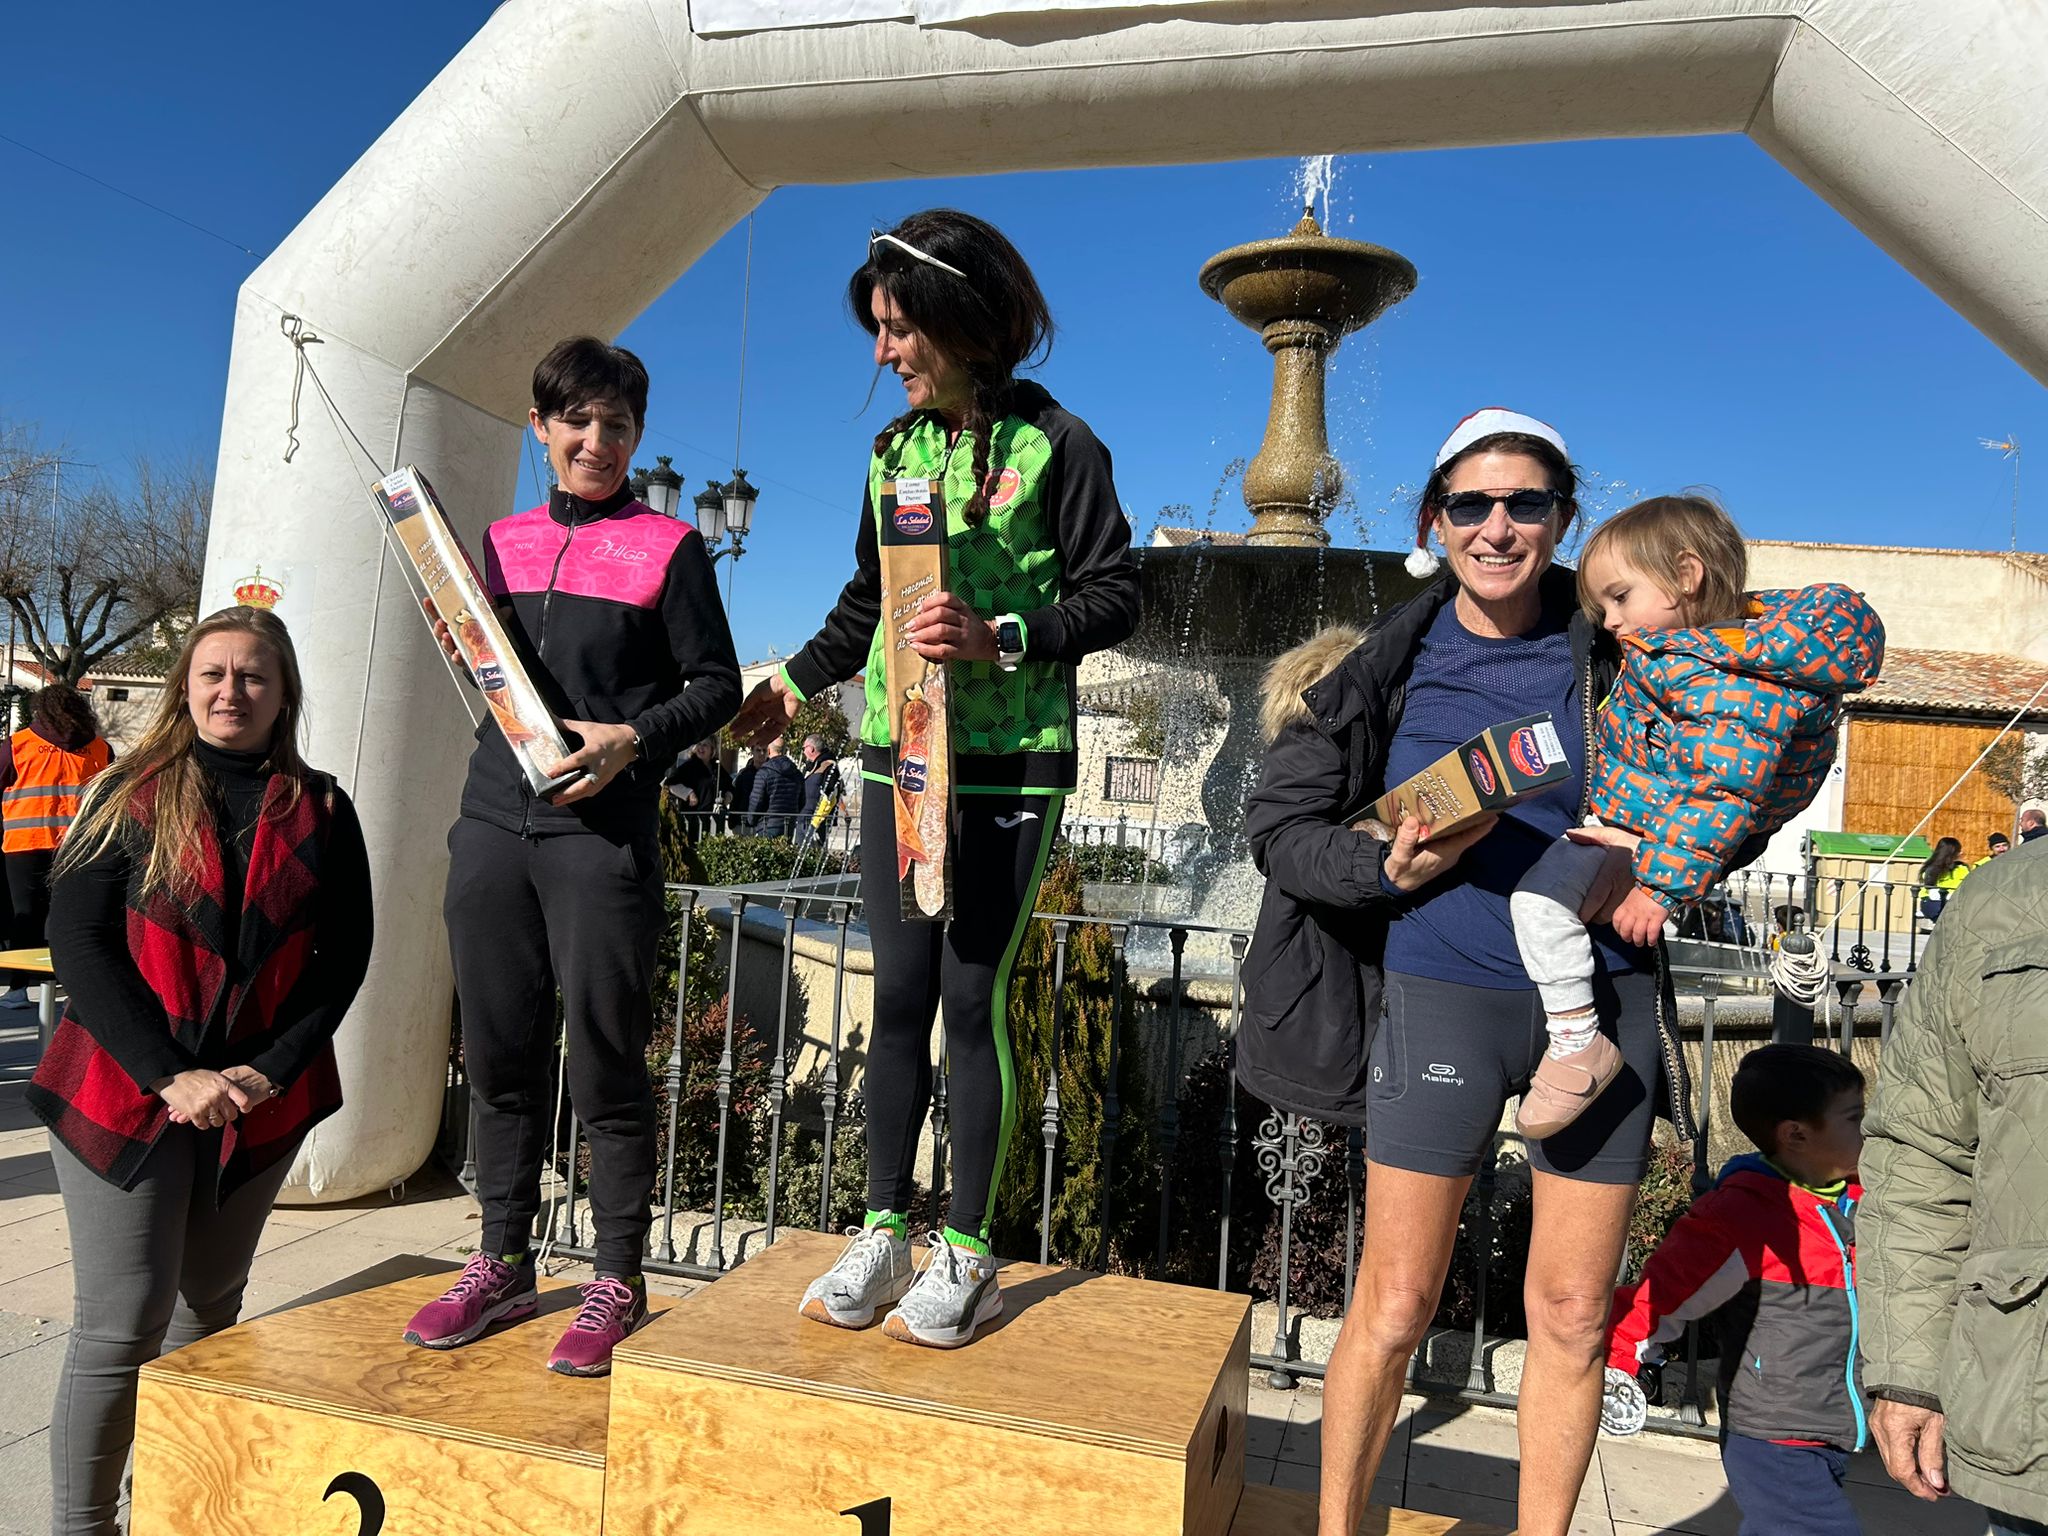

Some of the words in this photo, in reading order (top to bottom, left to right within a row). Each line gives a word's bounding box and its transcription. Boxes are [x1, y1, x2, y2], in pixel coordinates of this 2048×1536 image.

[897, 516, 907, 525] La
[901, 573, 934, 598] Hacemos
[893, 607, 902, 619] de
[903, 603, 911, 613] lo
[897, 634, 906, 651] de
[1424, 772, 1433, 780] de
[1436, 790, 1461, 819] natural
[1437, 775, 1464, 809] Hacemos
[1421, 1072, 1465, 1086] Kalenji
